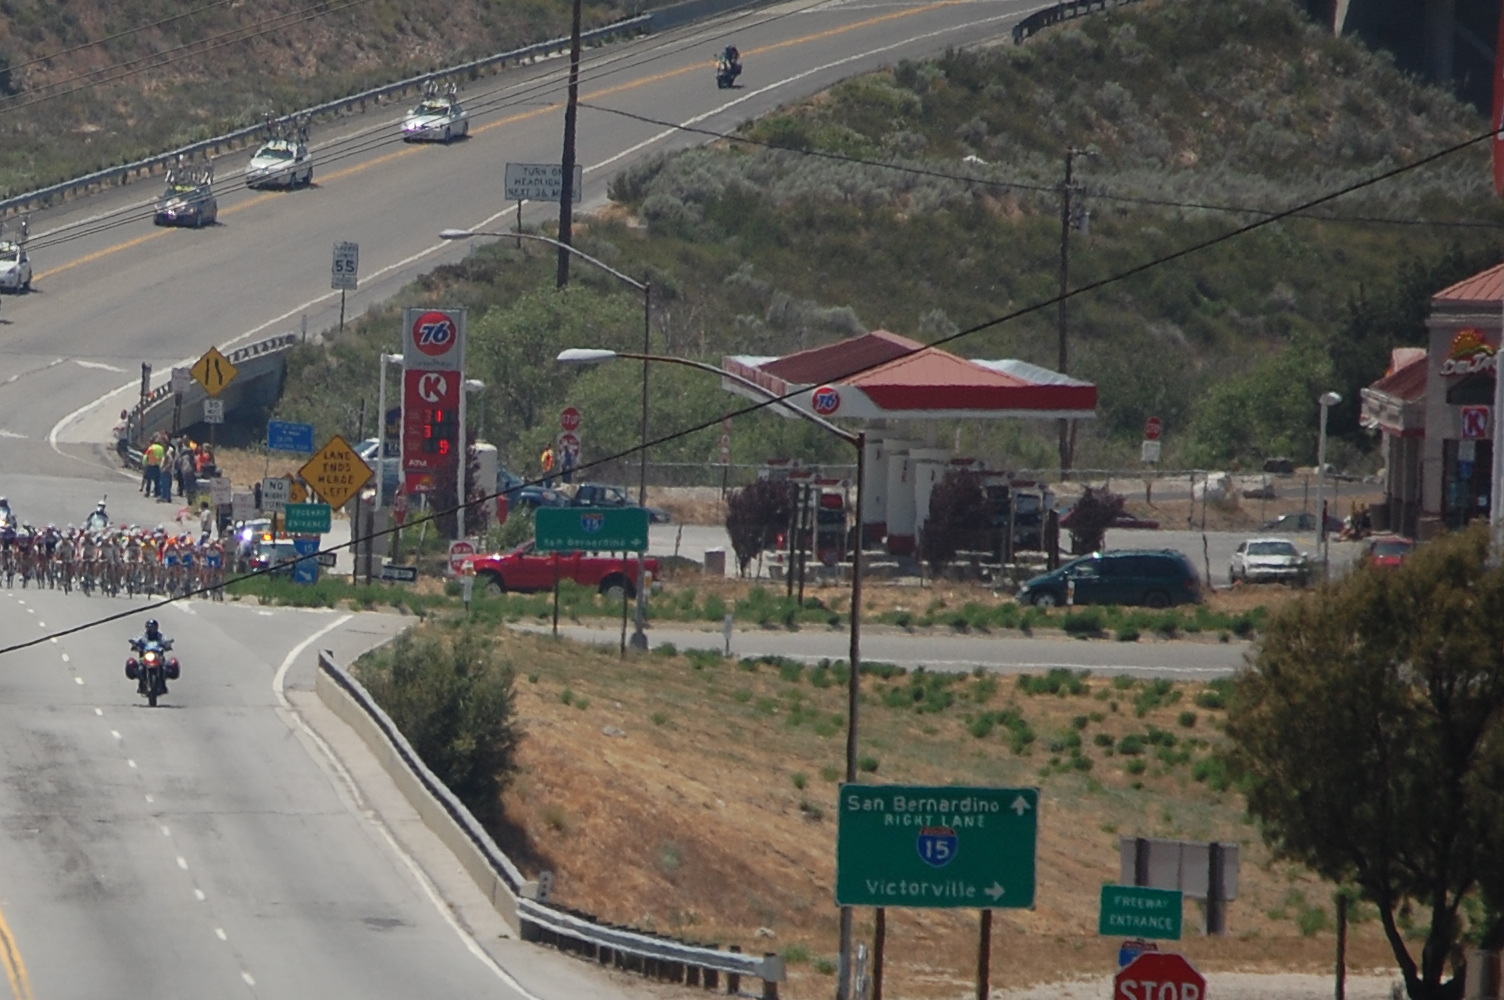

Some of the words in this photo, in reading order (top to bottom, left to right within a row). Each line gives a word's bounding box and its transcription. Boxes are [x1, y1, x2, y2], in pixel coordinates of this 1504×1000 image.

[515, 178, 561, 187] HEADLIGH
[336, 260, 355, 273] 55
[419, 321, 450, 345] 76
[817, 393, 837, 410] 76
[324, 451, 351, 460] LANE
[323, 463, 351, 472] ENDS
[269, 482, 284, 490] NO
[318, 475, 354, 484] MERGE
[323, 487, 350, 497] LEFT
[848, 795, 885, 812] San
[894, 796, 999, 813] Bernardino
[884, 814, 933, 827] RIGHT
[942, 815, 985, 828] LANE
[926, 840, 950, 860] 15
[866, 879, 976, 898] Victorville
[1114, 895, 1169, 909] FREEWAY
[1109, 914, 1174, 931] ENTRANCE
